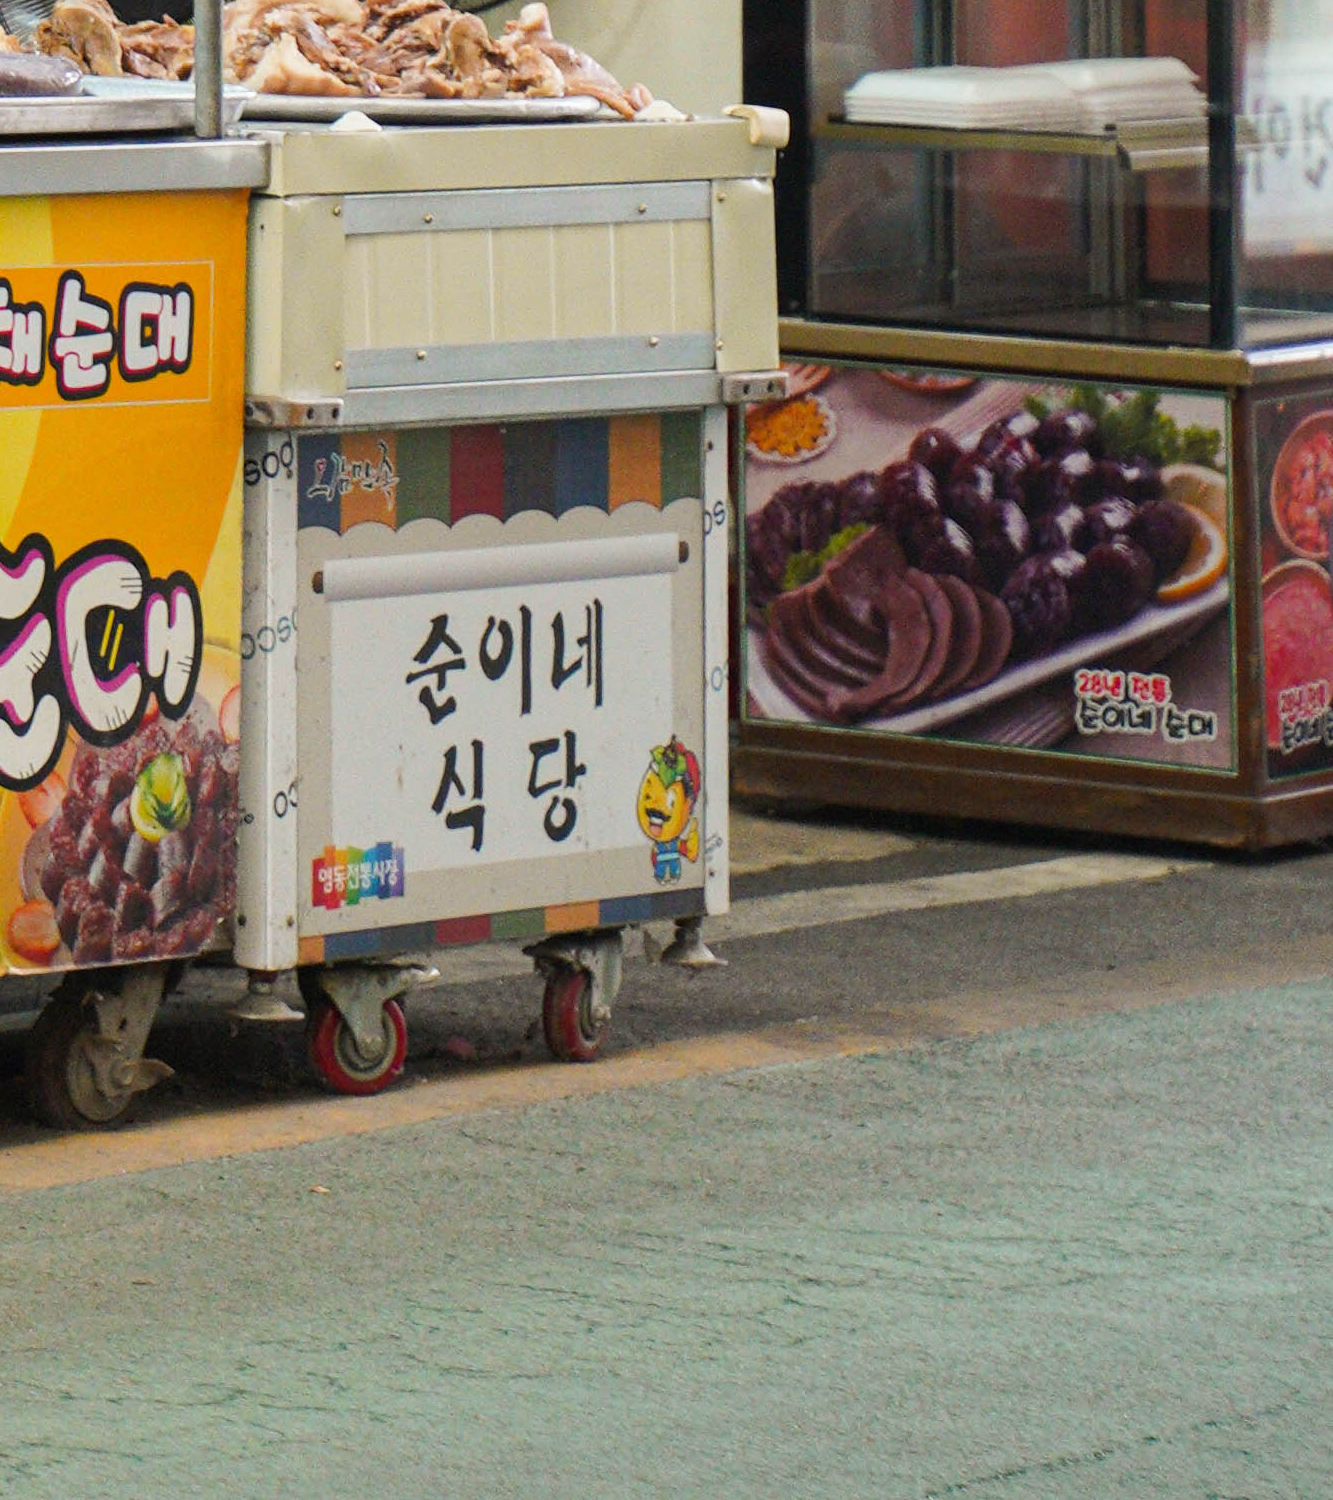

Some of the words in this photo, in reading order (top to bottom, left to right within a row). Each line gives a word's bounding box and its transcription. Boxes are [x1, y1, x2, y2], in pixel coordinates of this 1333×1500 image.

[406, 598, 605, 727] 순이네
[1079, 701, 1154, 731] 순이네
[1166, 706, 1215, 740] 순대
[431, 732, 588, 853] 식당
[318, 855, 398, 895] 영동전통시장
